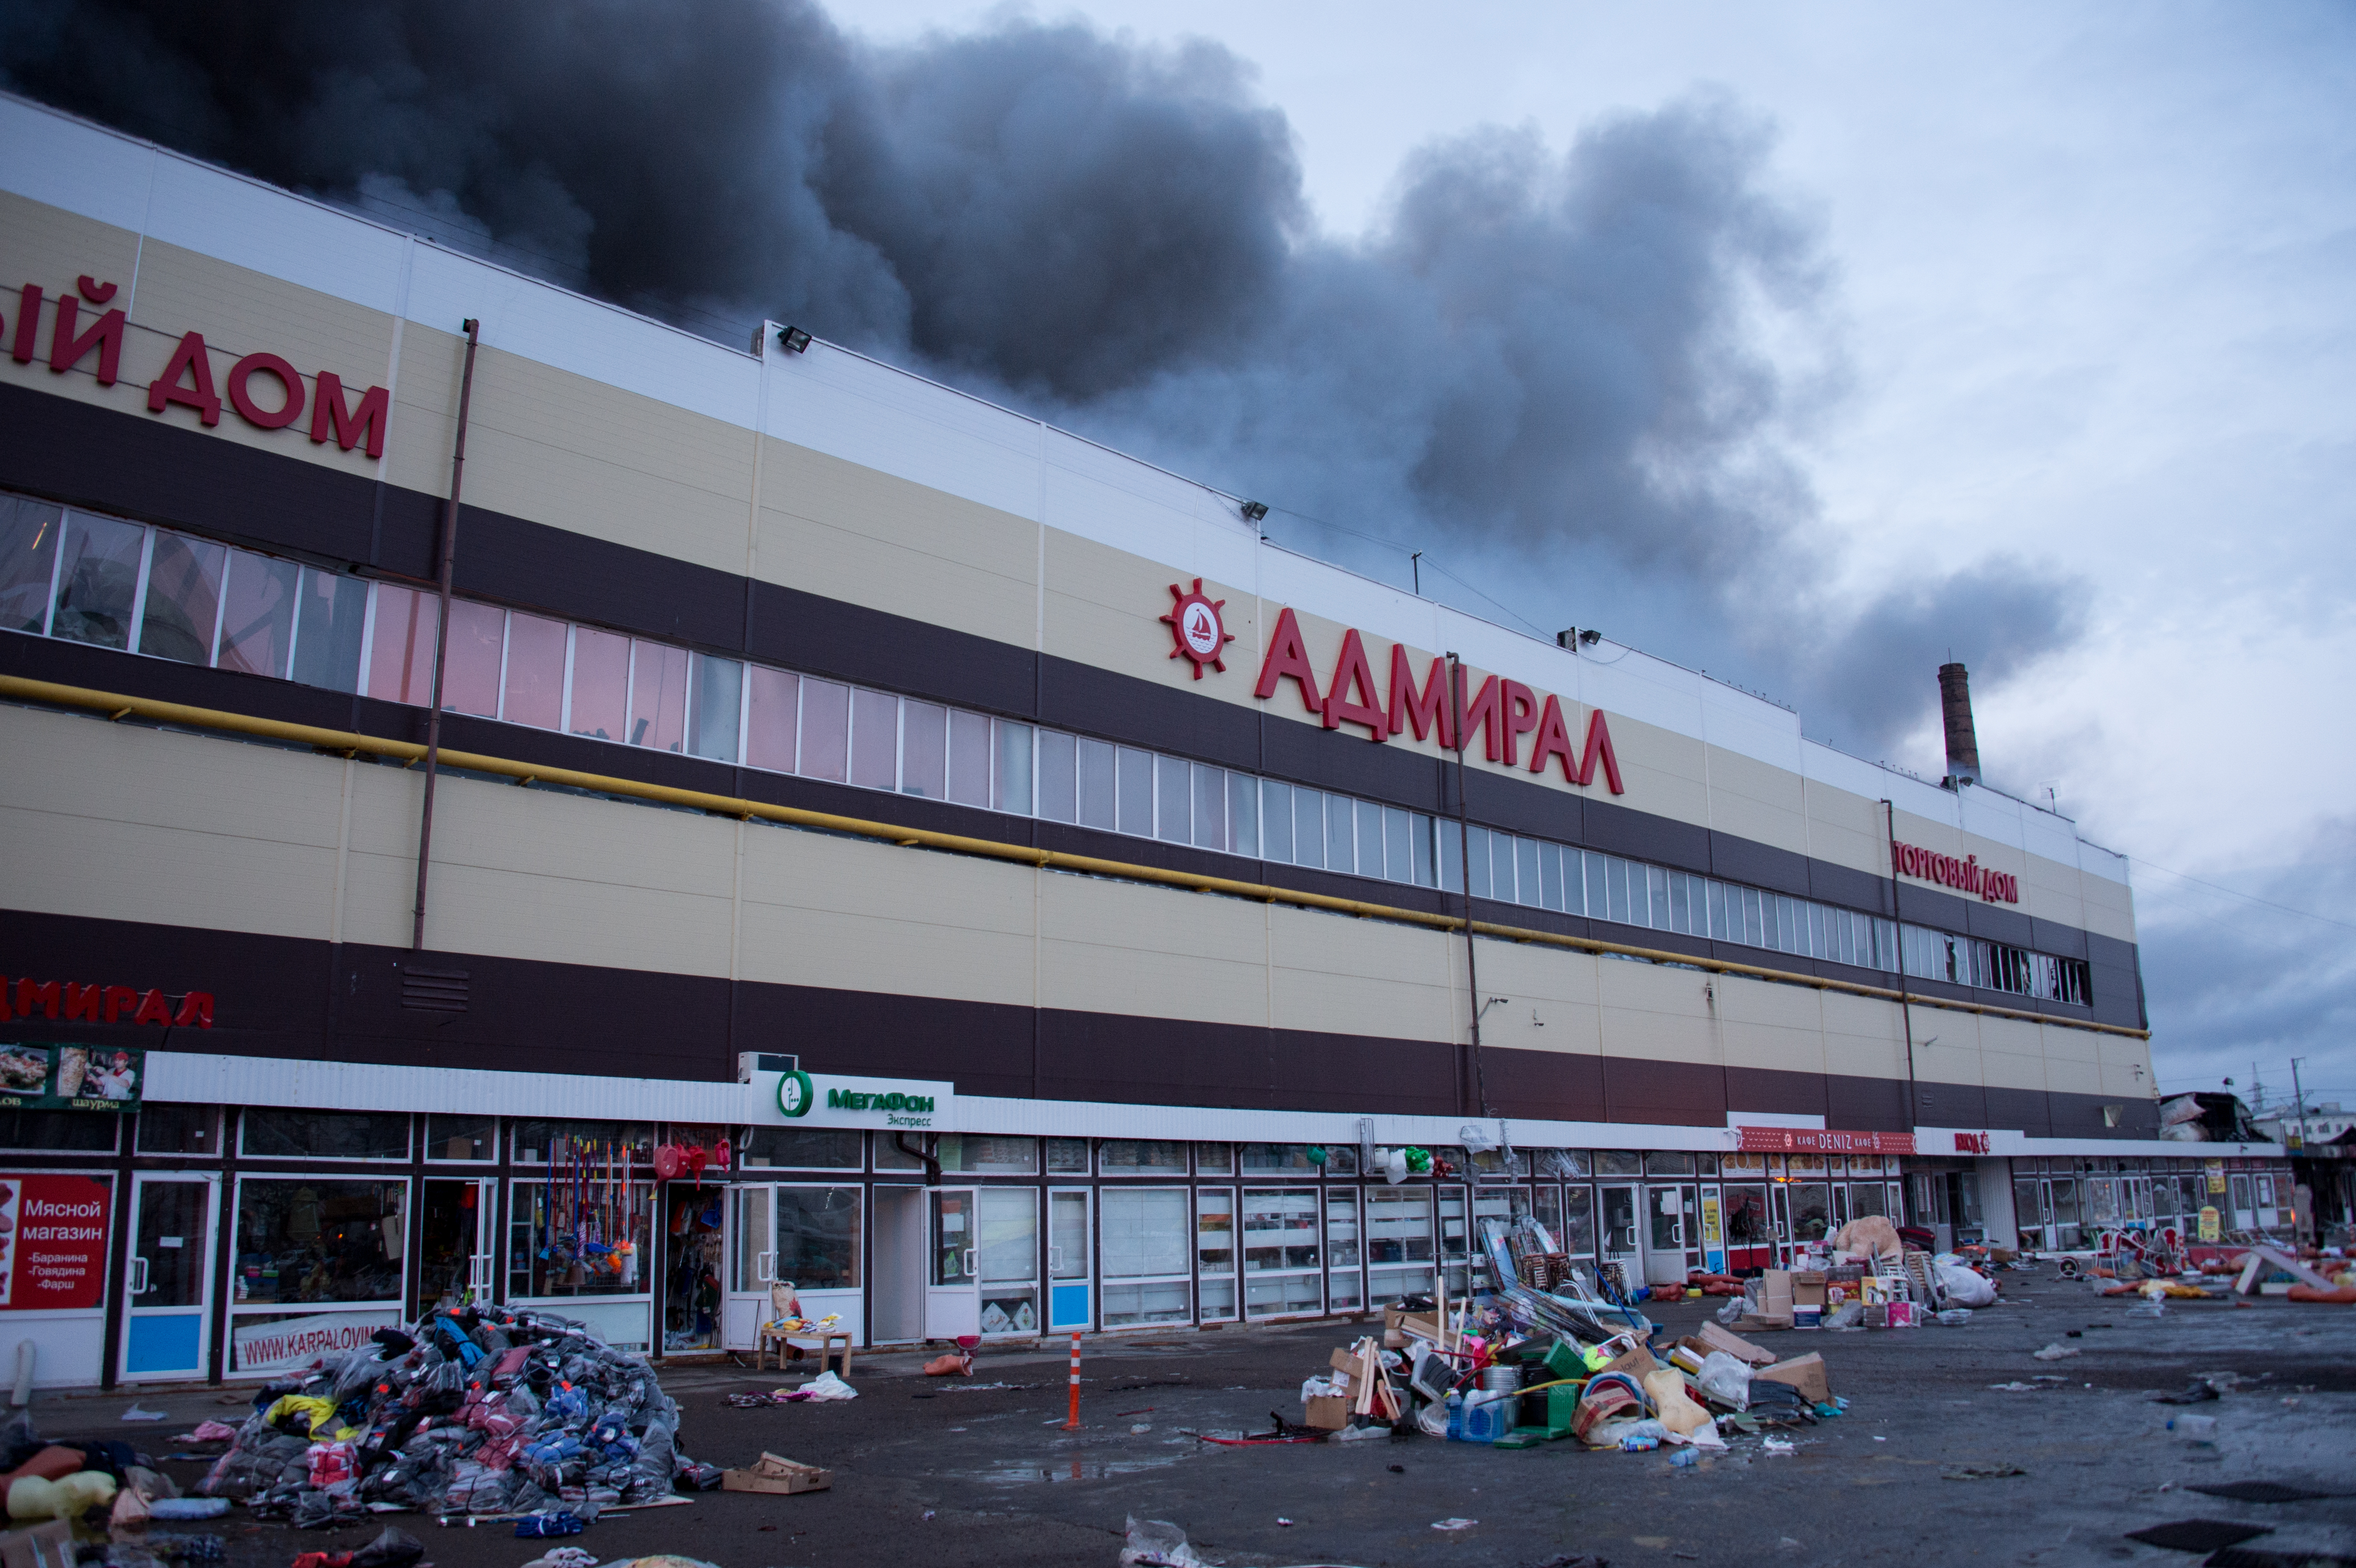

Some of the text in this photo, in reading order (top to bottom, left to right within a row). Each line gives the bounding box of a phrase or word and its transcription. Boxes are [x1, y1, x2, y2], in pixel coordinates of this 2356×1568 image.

[147, 331, 390, 459] ДОМ
[1253, 607, 1624, 795] АДМИРАЛ
[1893, 840, 2018, 903] ТОРГОВЫЙ ДОМ
[0, 975, 215, 1029] МИРАЛ
[72, 1099, 119, 1111] шаурма
[887, 1113, 931, 1128] Экспресс
[1797, 1133, 1871, 1149] КАФЕ DENIZ КАФЕ
[25, 1199, 101, 1218] Мясной
[23, 1226, 103, 1241] магазин
[28, 1252, 88, 1265] -Баранина
[28, 1266, 86, 1278] -Говядина
[37, 1280, 75, 1291] -Фарш
